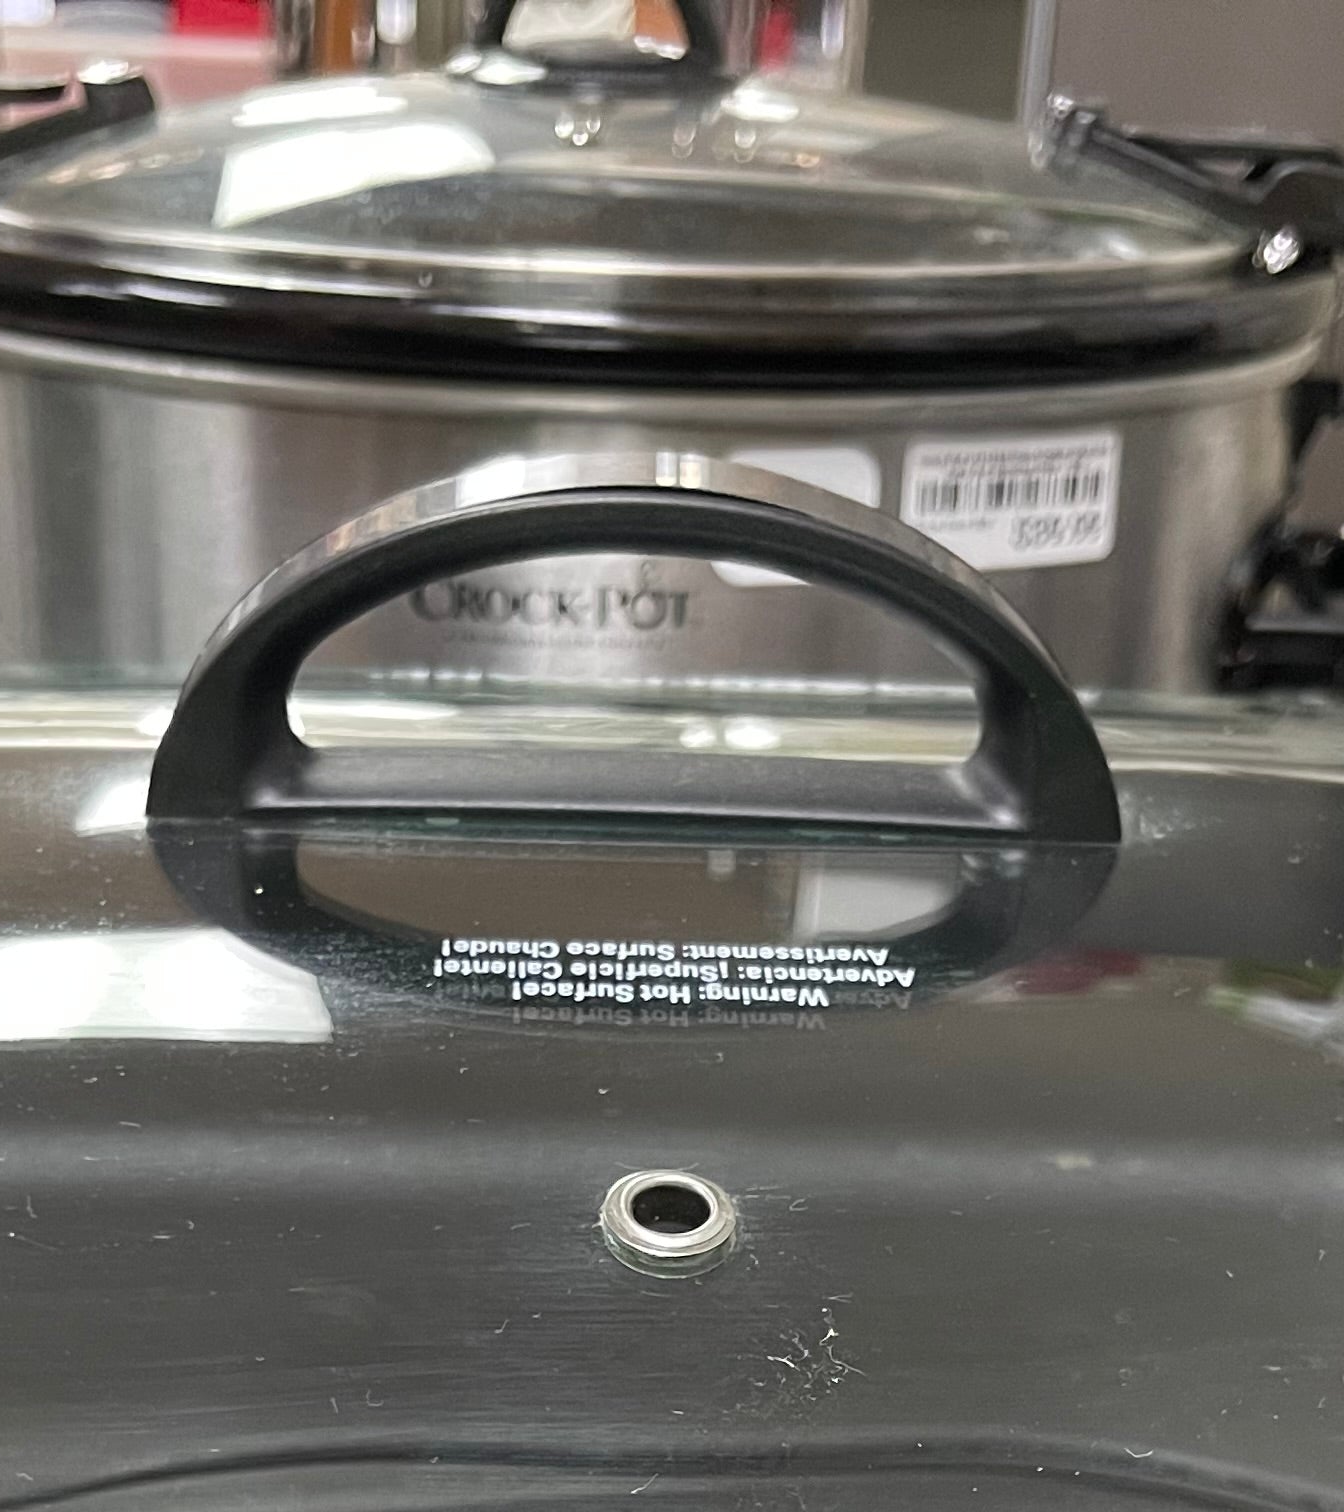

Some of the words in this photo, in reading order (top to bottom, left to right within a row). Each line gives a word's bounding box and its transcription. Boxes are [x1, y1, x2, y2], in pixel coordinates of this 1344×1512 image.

[441, 938, 561, 959] Chaude!
[565, 941, 675, 961] Surface
[683, 944, 890, 966] Avertissement:
[433, 958, 563, 979] Caliente!
[737, 966, 916, 988] Advertencia:
[512, 981, 635, 1003] Surface!
[640, 984, 691, 1004] Hot
[698, 983, 830, 1007] Warning:
